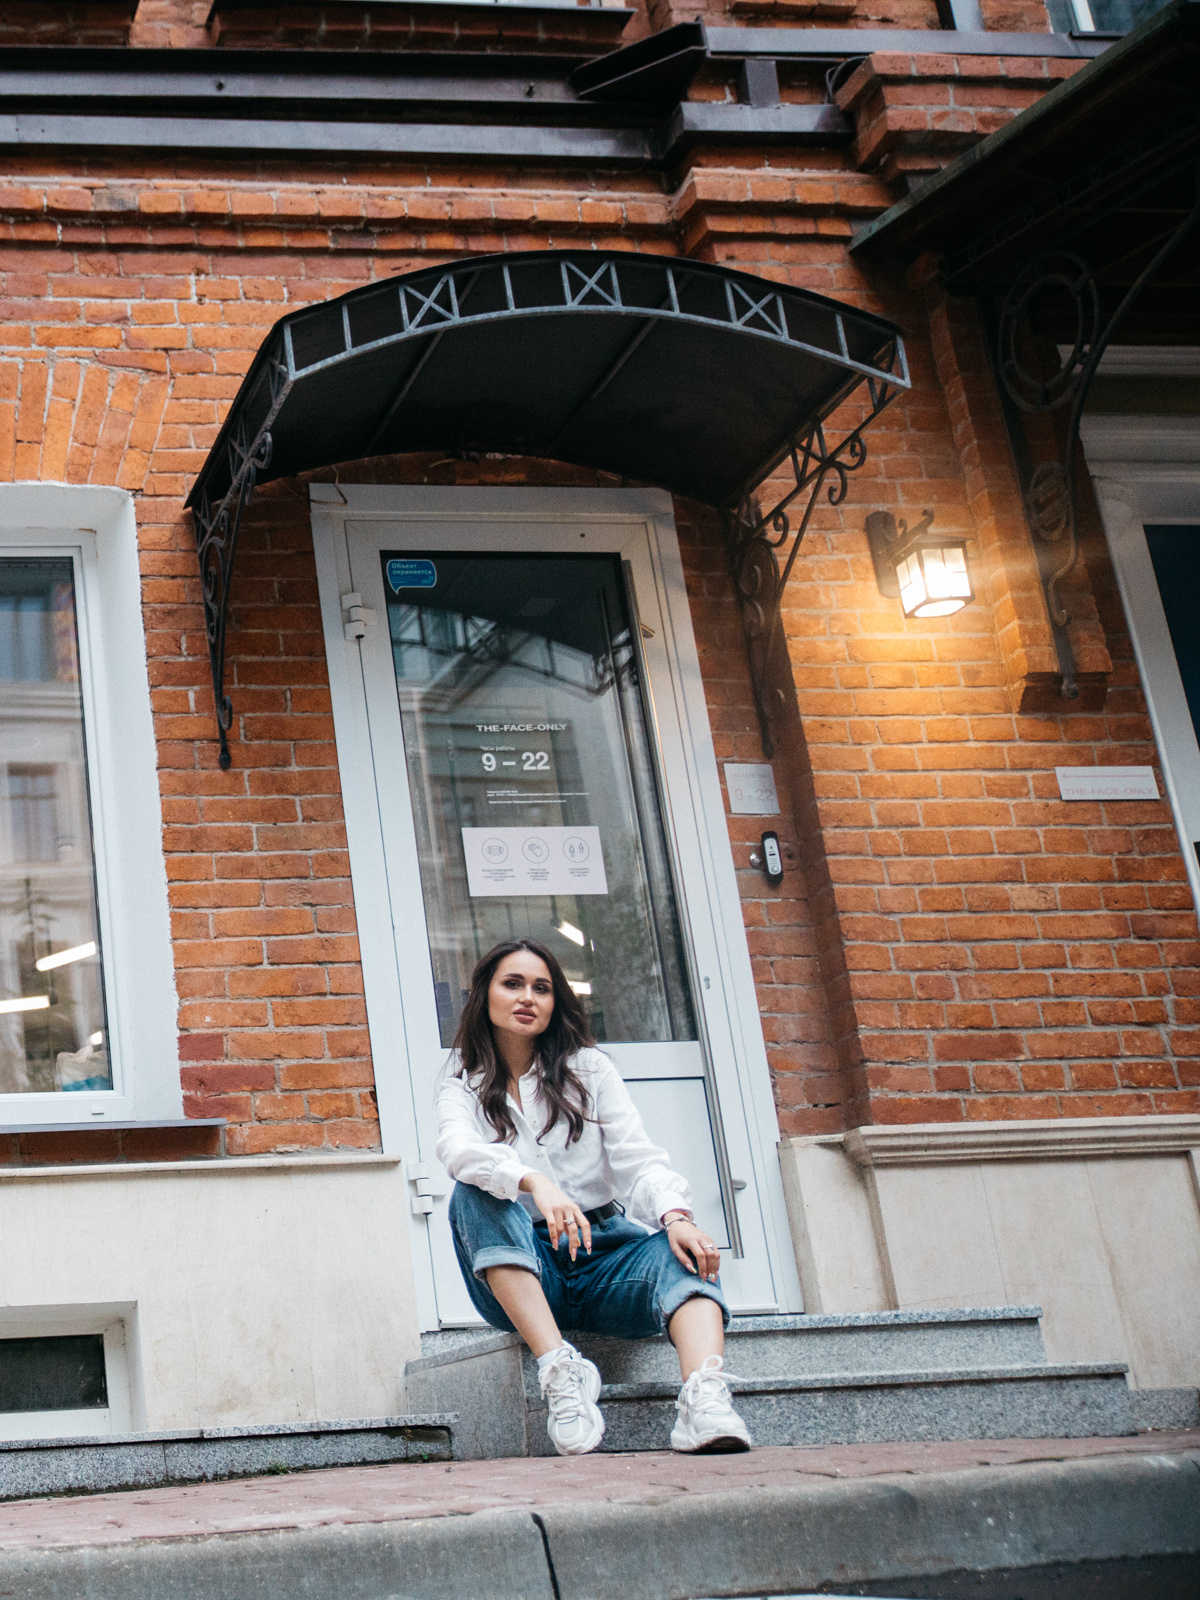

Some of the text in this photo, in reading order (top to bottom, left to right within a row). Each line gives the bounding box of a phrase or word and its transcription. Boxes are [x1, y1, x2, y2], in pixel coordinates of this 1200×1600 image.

[476, 723, 567, 732] THE-FACE-ONLY
[481, 752, 497, 772] 9
[521, 751, 551, 771] 22
[735, 788, 744, 801] 9
[755, 788, 775, 802] 22
[1064, 787, 1154, 796] THE-FACE-ONLY
